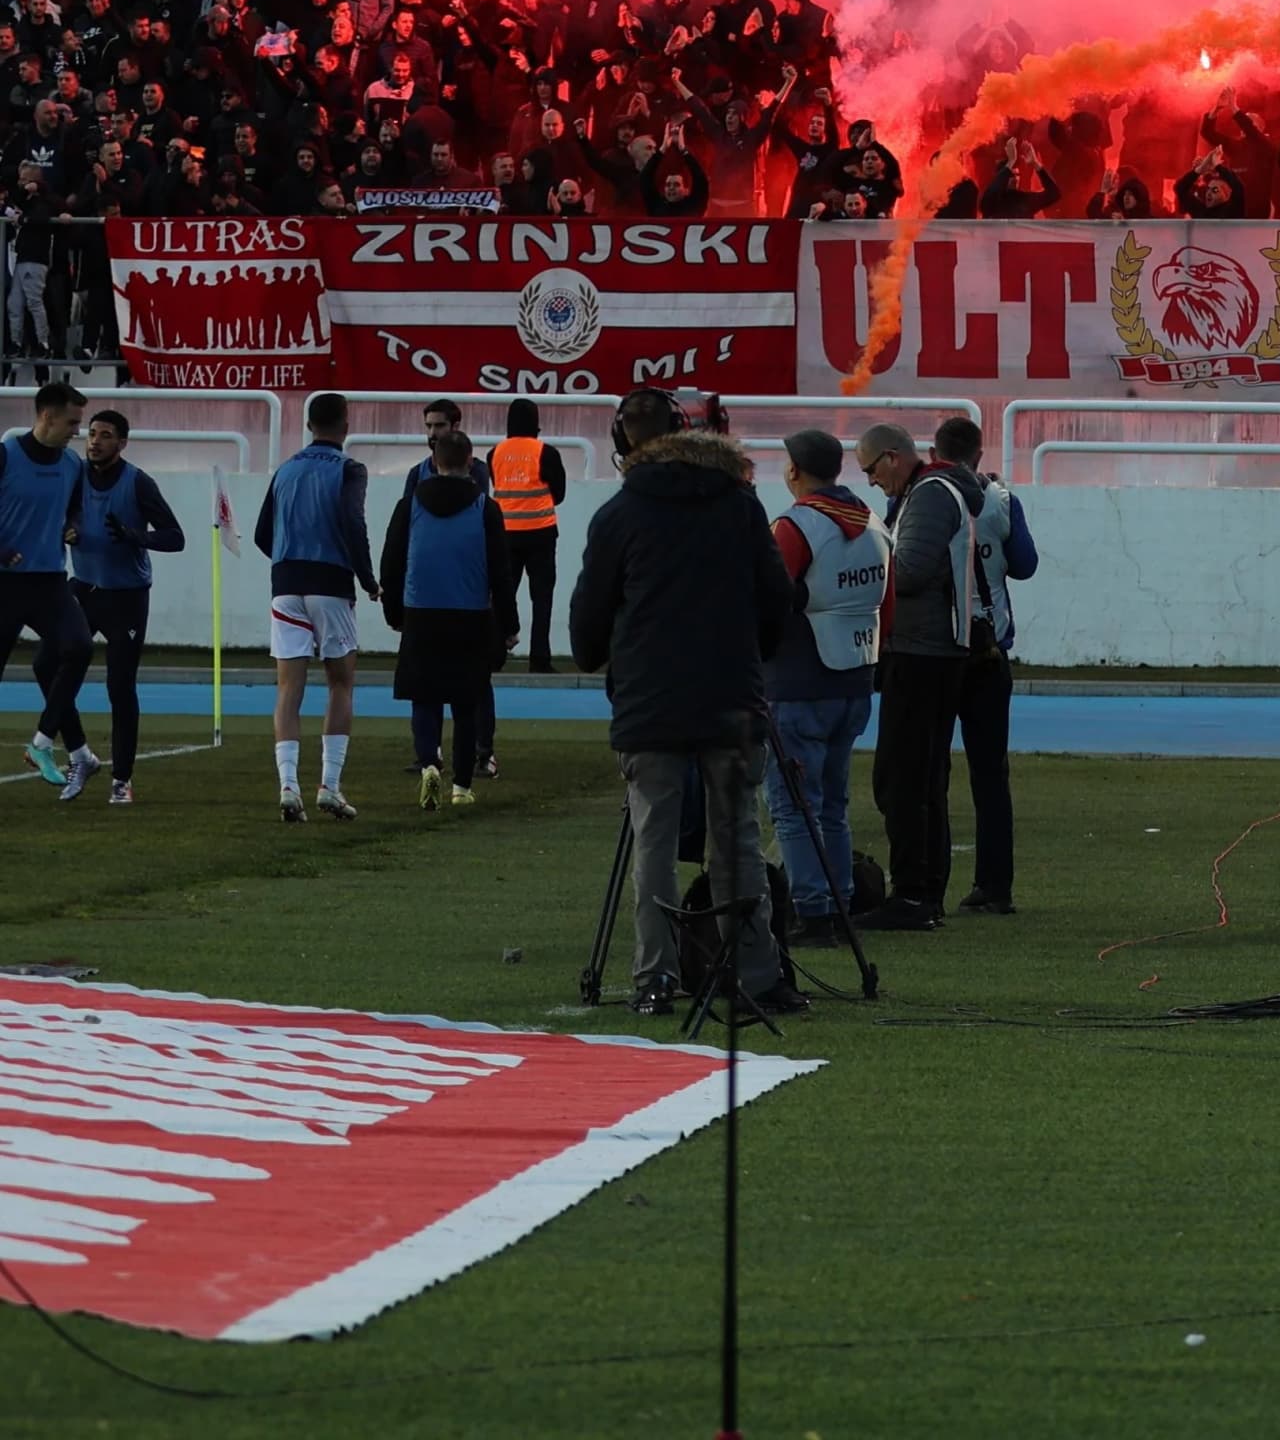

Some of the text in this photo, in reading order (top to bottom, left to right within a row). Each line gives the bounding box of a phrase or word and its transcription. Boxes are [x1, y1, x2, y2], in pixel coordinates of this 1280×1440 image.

[363, 190, 494, 206] MOSTARSKI
[131, 217, 306, 255] ULTRAS
[351, 222, 771, 264] ZRINJSKI
[144, 360, 306, 389] THE WAY OF LIFE
[376, 329, 448, 379] TO
[478, 363, 600, 394] SMO
[1168, 358, 1230, 381] 1994
[838, 563, 886, 589] PHOTO
